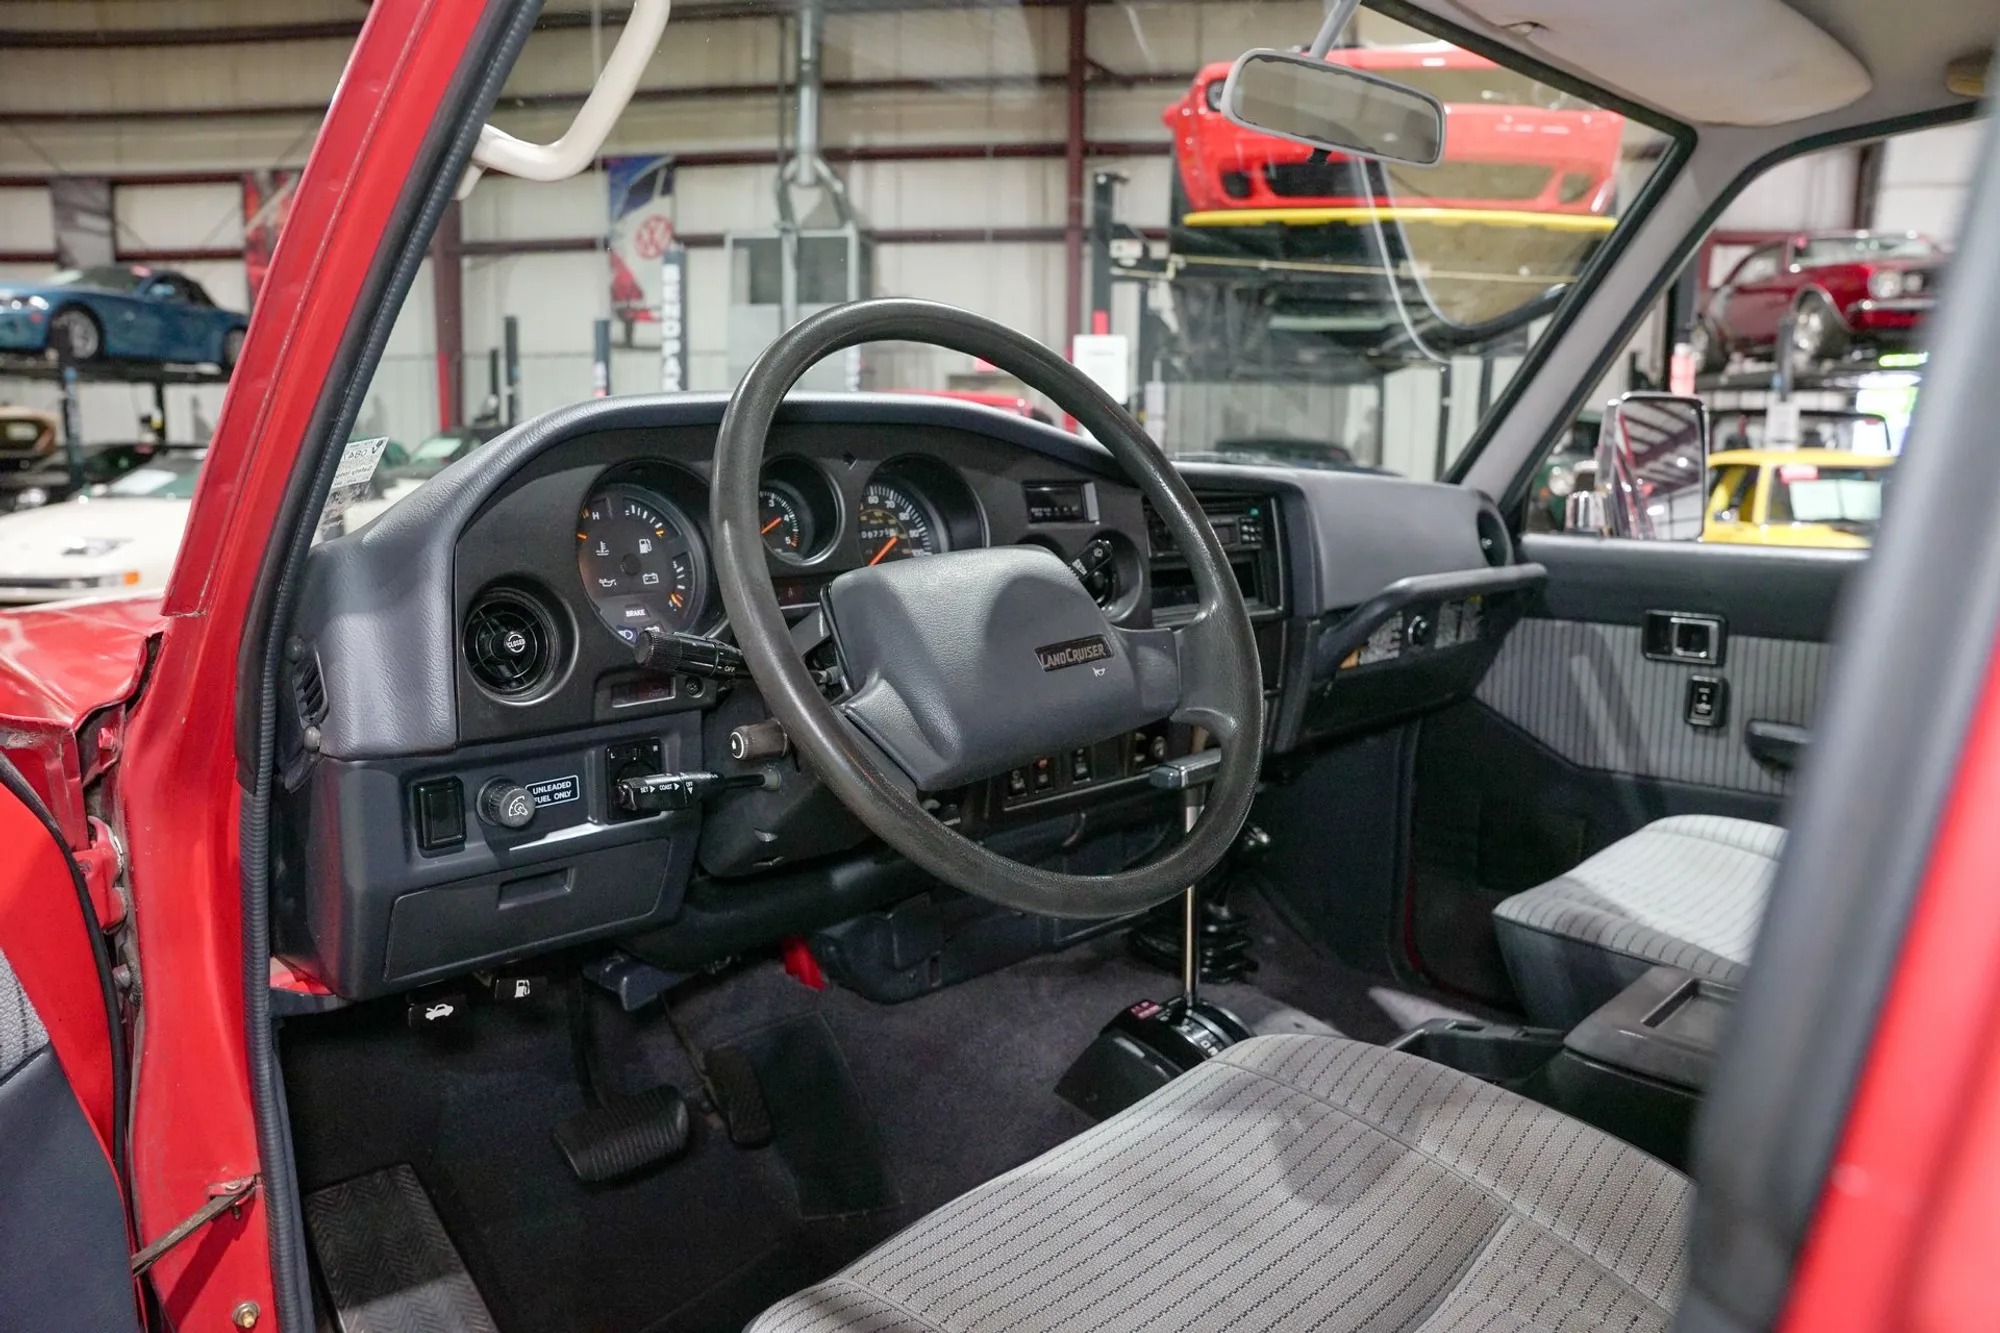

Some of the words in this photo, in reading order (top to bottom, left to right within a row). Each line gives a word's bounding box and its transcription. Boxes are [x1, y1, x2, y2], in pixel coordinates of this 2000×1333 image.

[768, 499, 775, 507] 3
[592, 511, 600, 520] H
[784, 514, 790, 522] 4
[785, 536, 791, 545] 5
[625, 608, 646, 617] BRAKE
[506, 638, 526, 648] CLOSED
[724, 665, 737, 673] OFF
[532, 781, 572, 795] UNLEADED
[553, 790, 572, 800] ONLY
